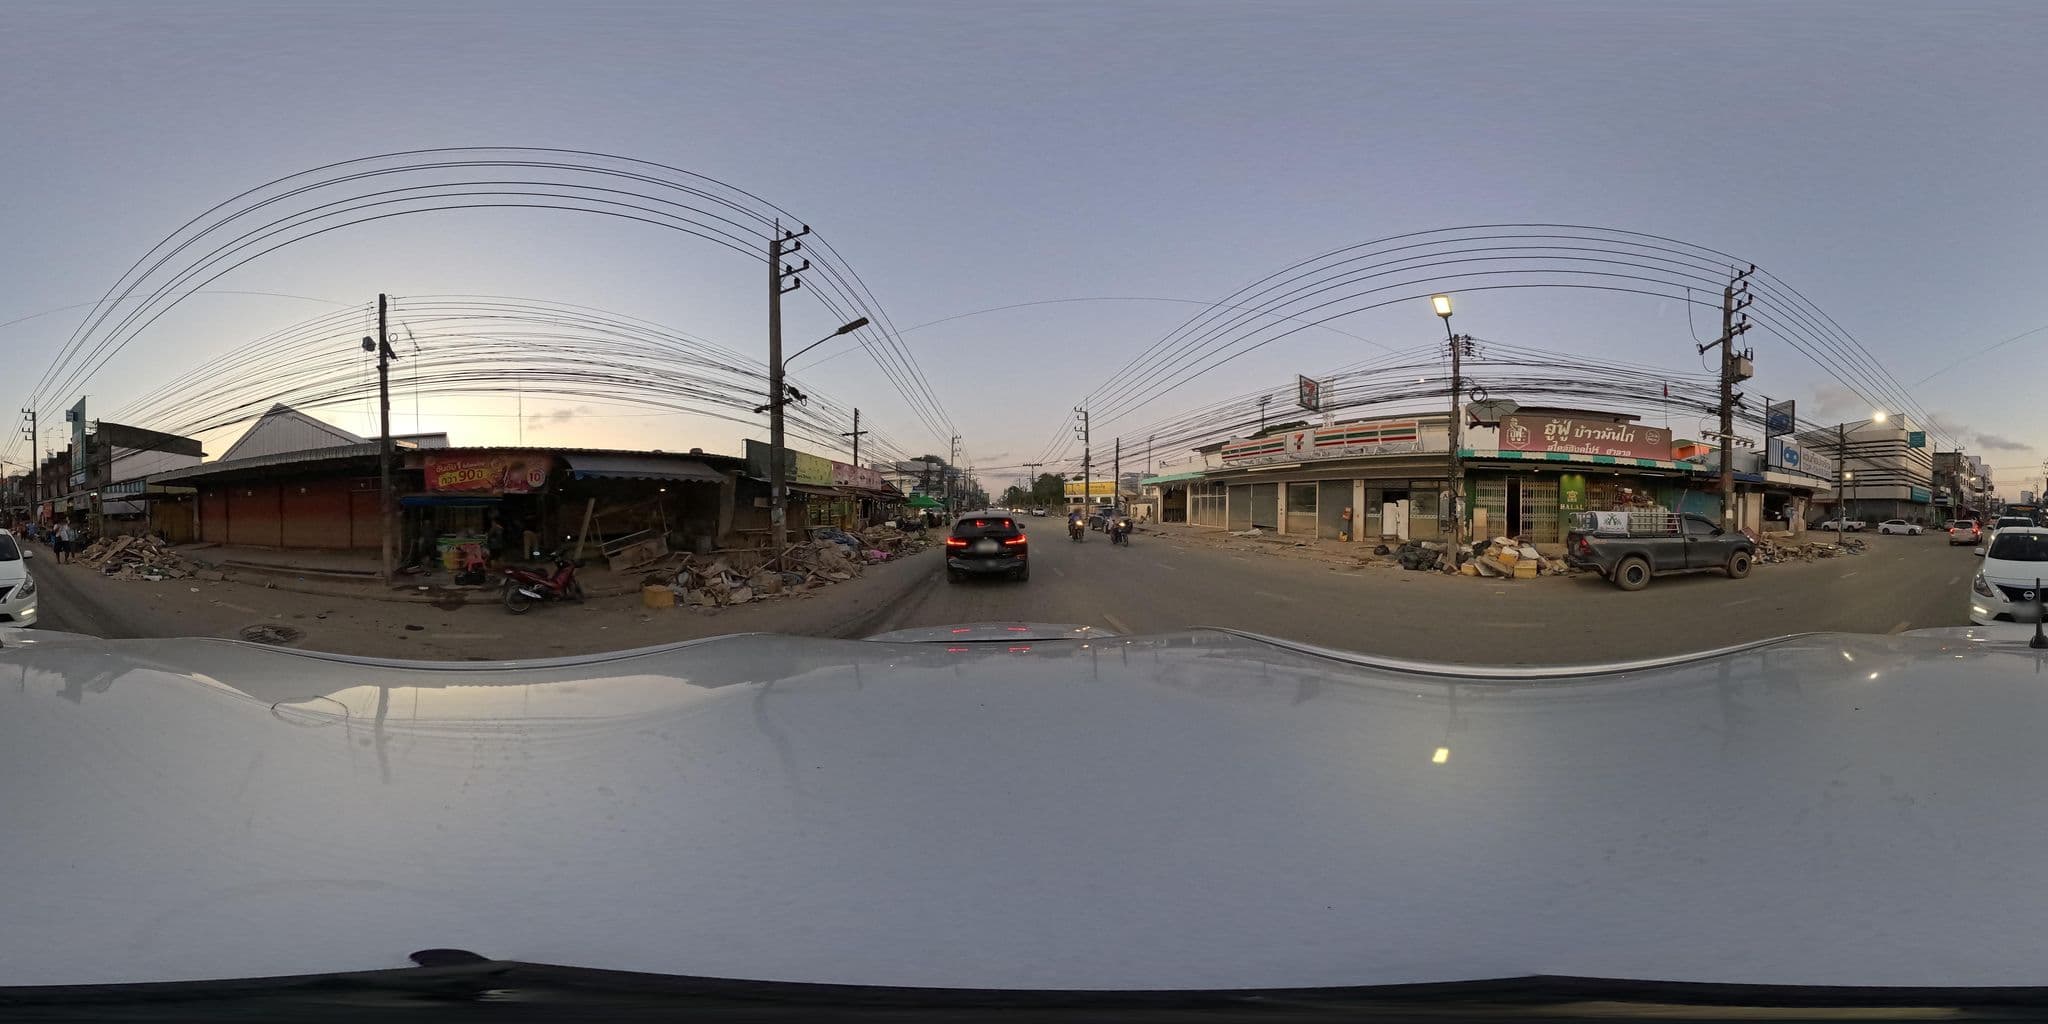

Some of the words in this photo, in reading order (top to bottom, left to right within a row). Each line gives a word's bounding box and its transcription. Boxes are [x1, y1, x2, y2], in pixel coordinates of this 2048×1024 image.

[1544, 418, 1572, 442] อู้ฟู่
[1575, 425, 1635, 443] ข้าวมันไก่
[458, 469, 476, 482] 90
[529, 472, 541, 482] 10
[1560, 503, 1584, 511] HALAL
